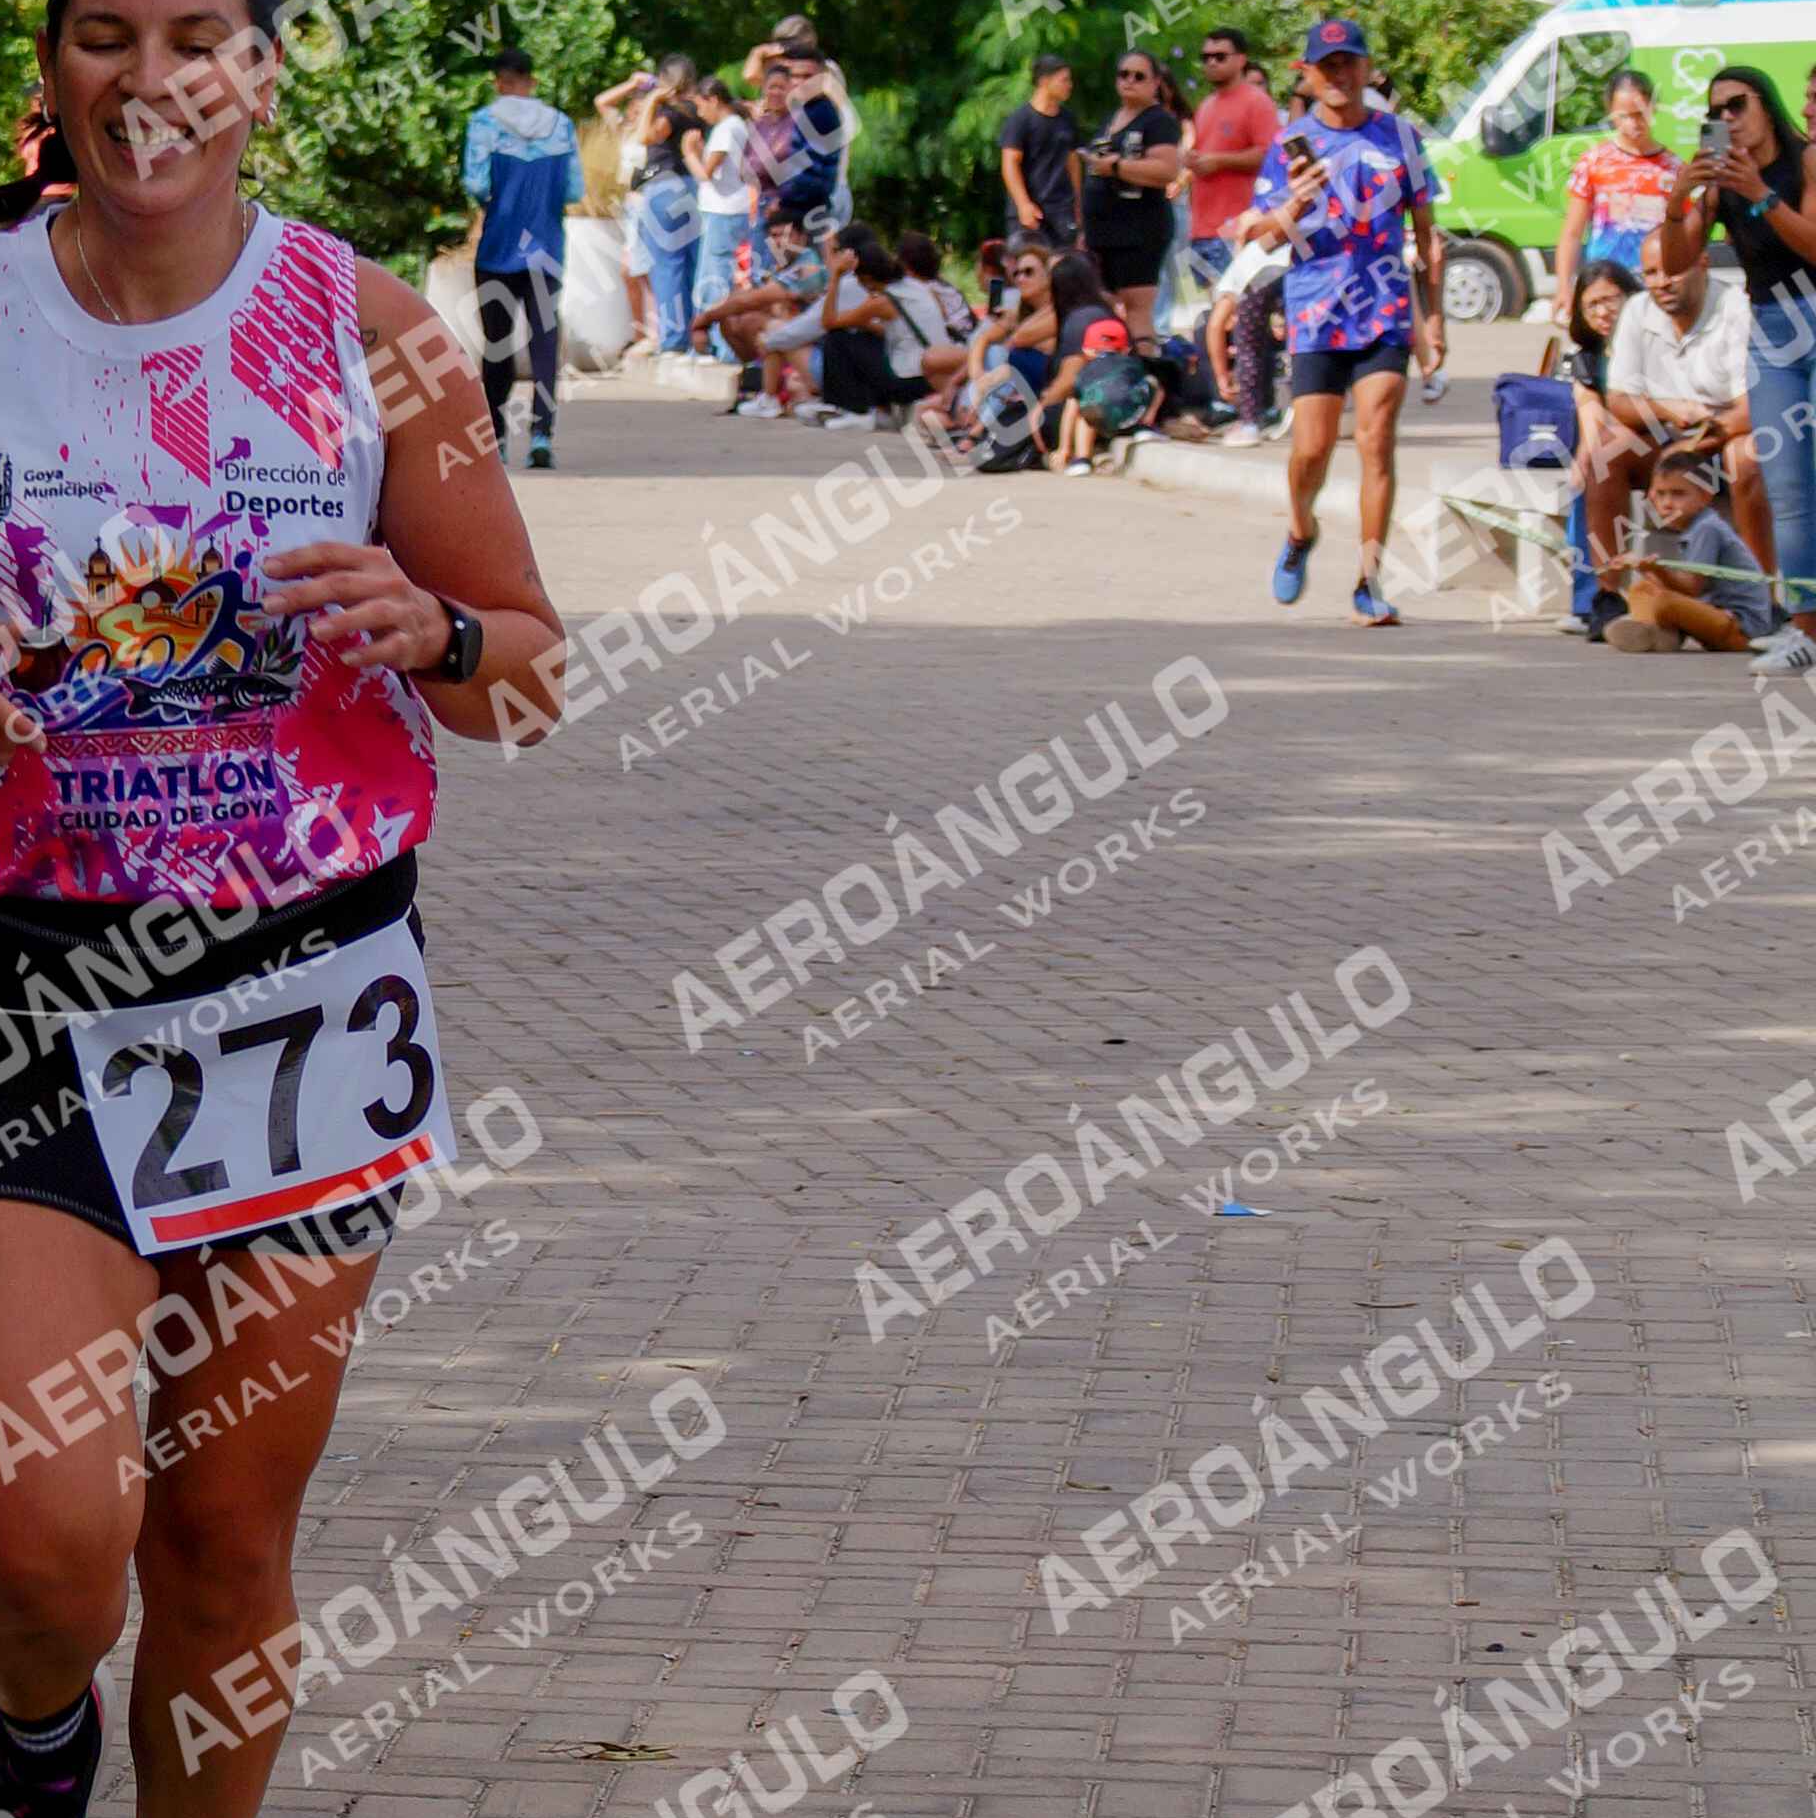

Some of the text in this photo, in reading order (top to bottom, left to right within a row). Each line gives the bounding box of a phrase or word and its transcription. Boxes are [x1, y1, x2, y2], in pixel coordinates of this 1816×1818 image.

[24, 469, 64, 483] Goya
[224, 461, 346, 487] Dirección de
[23, 483, 105, 498] Municipio
[225, 490, 345, 520] Deportes
[51, 753, 278, 804] TRIATLÓN
[59, 799, 280, 831] CIUDAD DE GOYA
[101, 974, 435, 1211] 273
